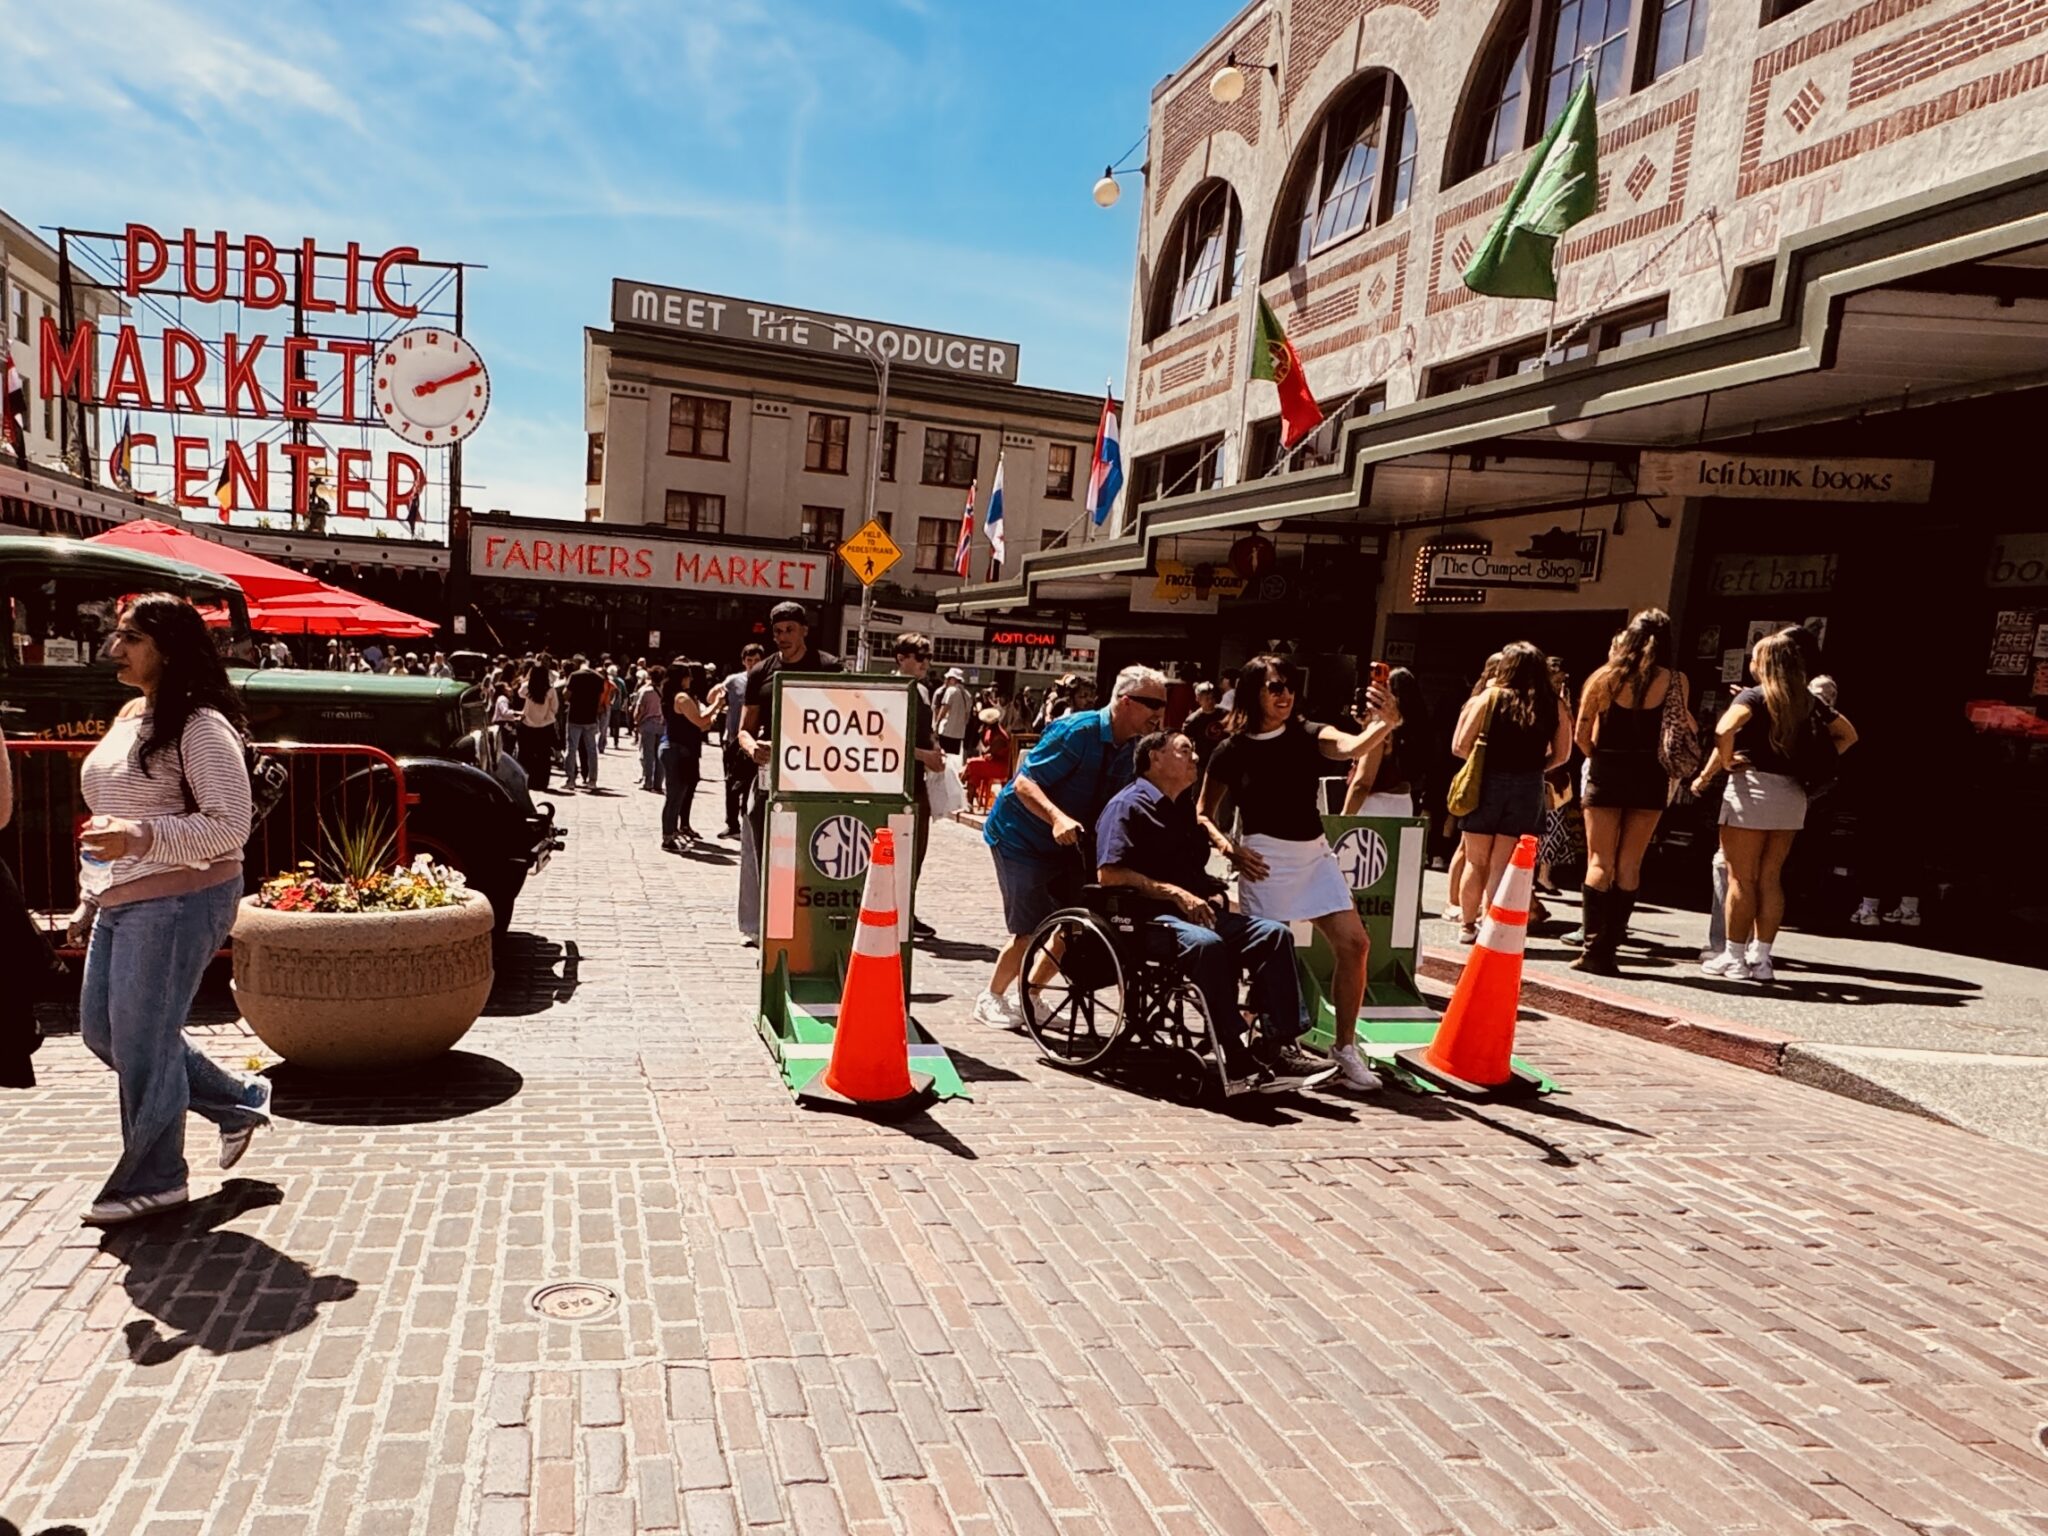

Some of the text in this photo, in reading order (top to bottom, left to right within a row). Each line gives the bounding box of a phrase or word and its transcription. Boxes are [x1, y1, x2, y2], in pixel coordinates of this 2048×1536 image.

[125, 223, 420, 319] PUBLIC
[426, 332, 438, 344] 12
[631, 289, 1006, 375] MEET THE PRODUCER
[403, 337, 412, 350] 11
[453, 341, 458, 353] 1
[385, 353, 396, 365] 10
[39, 316, 374, 423] MARKET
[378, 378, 387, 389] 9
[474, 385, 482, 397] 3
[384, 403, 393, 414] 8
[466, 409, 475, 420] 4
[402, 422, 410, 433] 7
[450, 425, 458, 437] 5
[425, 430, 433, 441] 6
[109, 432, 428, 523] CENTER
[1738, 461, 1803, 487] bank
[1811, 465, 1893, 491] books
[846, 545, 893, 554] PEDESTRIANS
[485, 536, 816, 591] FARMERS MARKET
[1992, 543, 2048, 582] bo
[1441, 556, 1575, 585] The Crumpet Shop
[1711, 554, 1839, 592] left bank
[2000, 612, 2034, 626] FREE
[991, 631, 1057, 646] ADITI CHAI
[1998, 633, 2031, 647] FREE
[1992, 653, 2027, 667] FREE
[802, 708, 885, 736] ROAD
[56, 720, 106, 739] PLACE
[784, 745, 899, 773] CLOSED
[797, 886, 861, 908] Seatt
